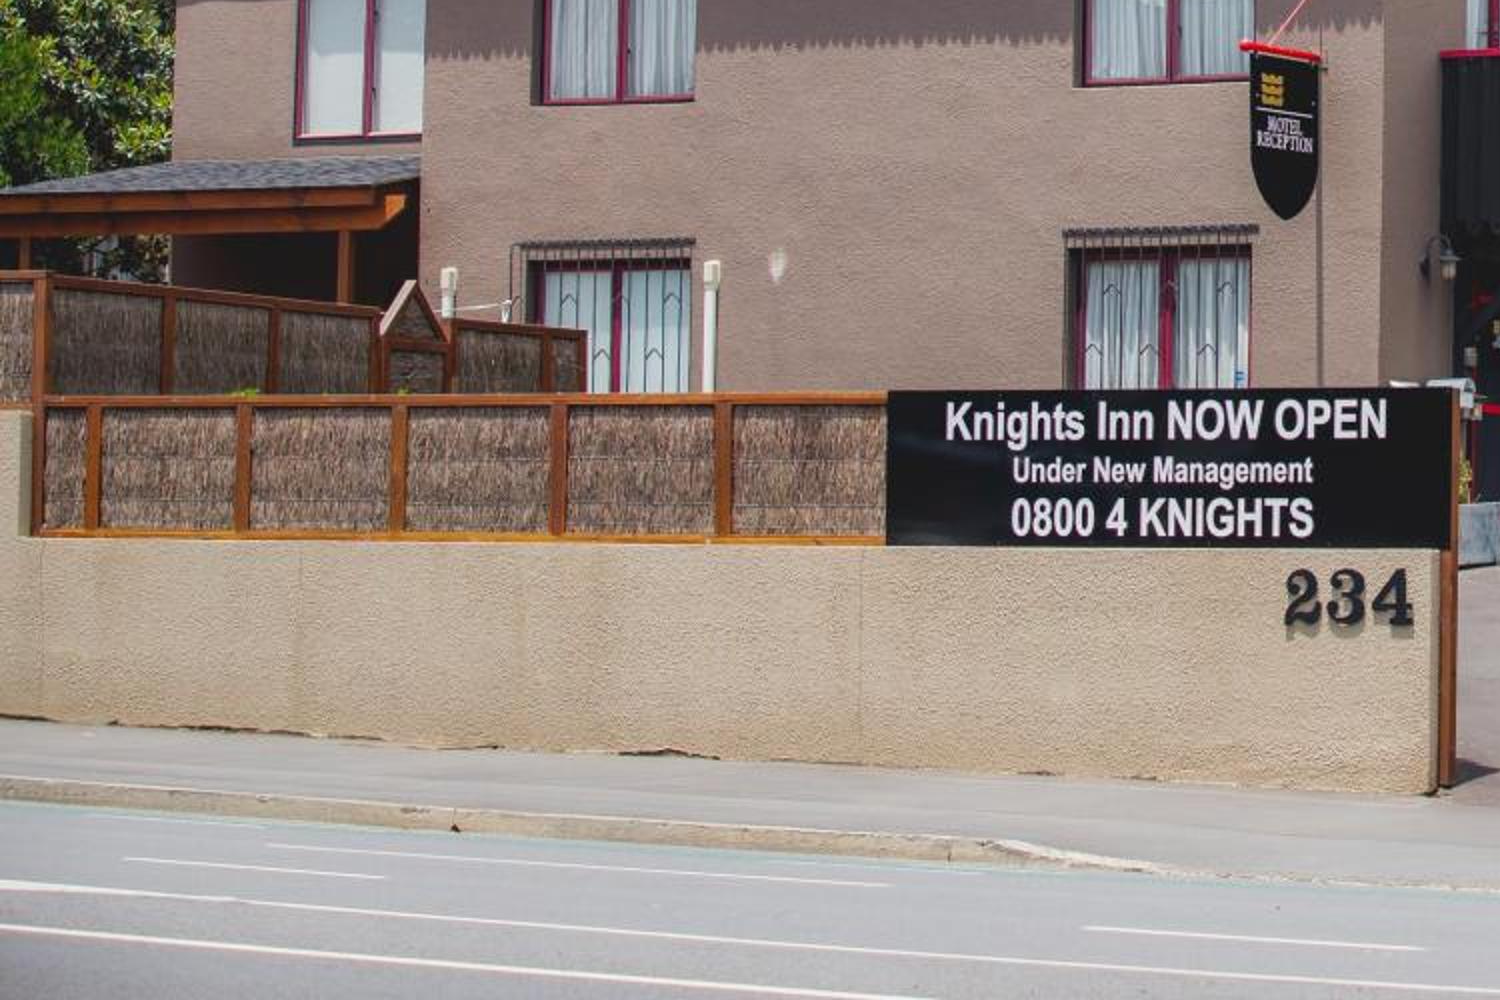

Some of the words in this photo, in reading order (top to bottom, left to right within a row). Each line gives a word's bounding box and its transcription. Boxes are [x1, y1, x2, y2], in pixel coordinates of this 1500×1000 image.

[1257, 129, 1313, 153] RECEPTION
[1267, 114, 1303, 137] MOTEL
[946, 401, 1085, 452] Knights
[1097, 400, 1154, 441] Inn
[1167, 399, 1265, 441] NOW
[1274, 398, 1387, 441] OPEN
[1013, 456, 1087, 484] Under
[1093, 455, 1147, 484] New
[1153, 455, 1314, 491] Management
[1011, 497, 1095, 537] 0800
[1105, 497, 1128, 537] 4
[1139, 497, 1315, 539] KNIGHTS
[1284, 568, 1414, 628] 234
